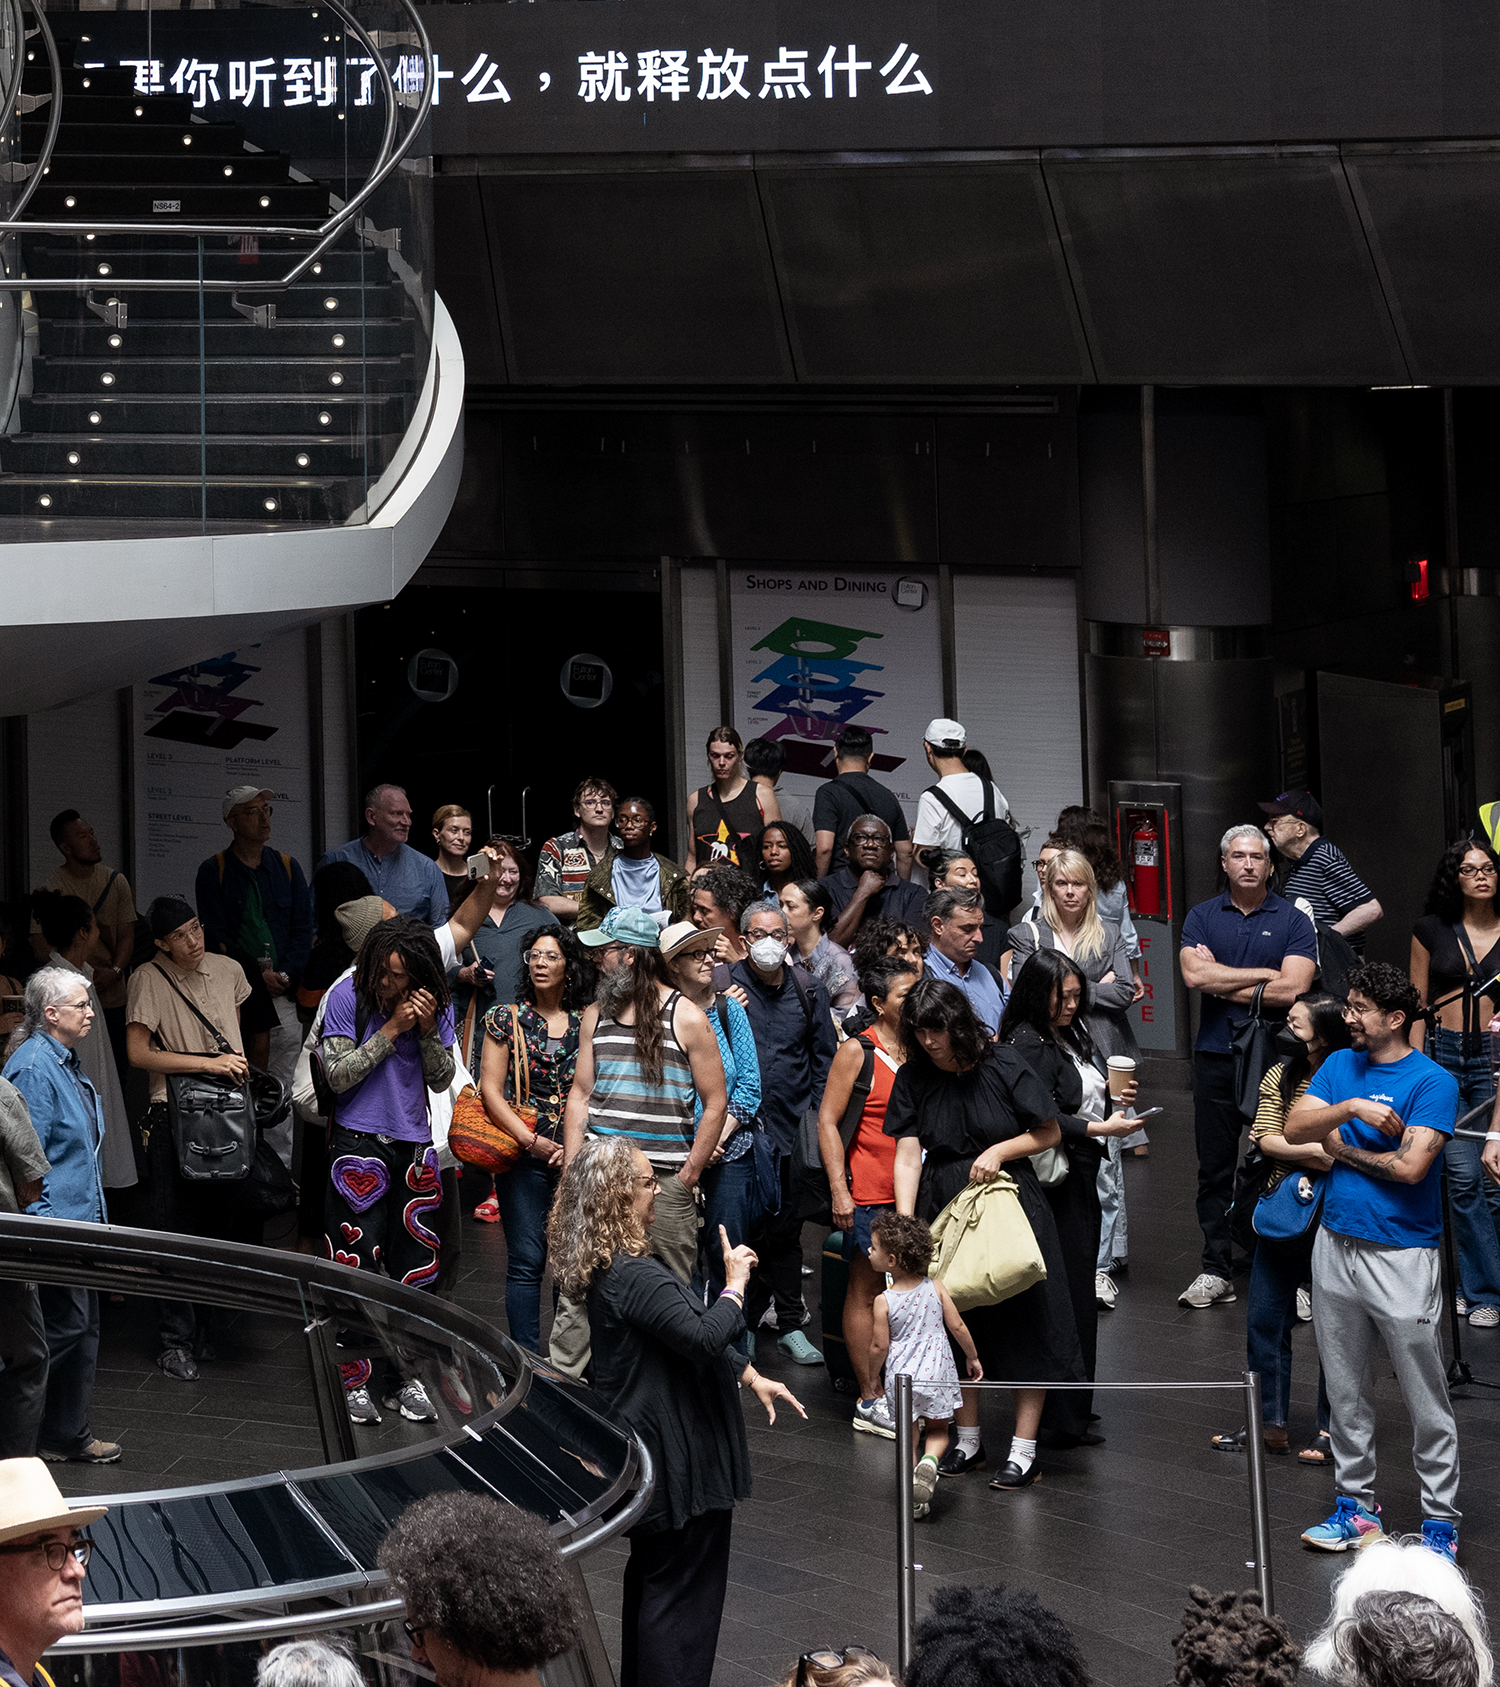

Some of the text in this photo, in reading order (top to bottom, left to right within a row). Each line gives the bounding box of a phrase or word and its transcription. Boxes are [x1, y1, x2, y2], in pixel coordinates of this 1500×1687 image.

[153, 201, 180, 213] NS64-2
[798, 579, 829, 592] AND
[420, 660, 441, 668] Fulton
[419, 667, 443, 676] Center
[573, 665, 595, 674] Fulton
[572, 673, 598, 682] Center
[147, 752, 168, 760] LEVEL
[225, 757, 260, 765] PLATFORM
[172, 814, 193, 822] LEVEL
[1138, 937, 1154, 1023] FIRE
